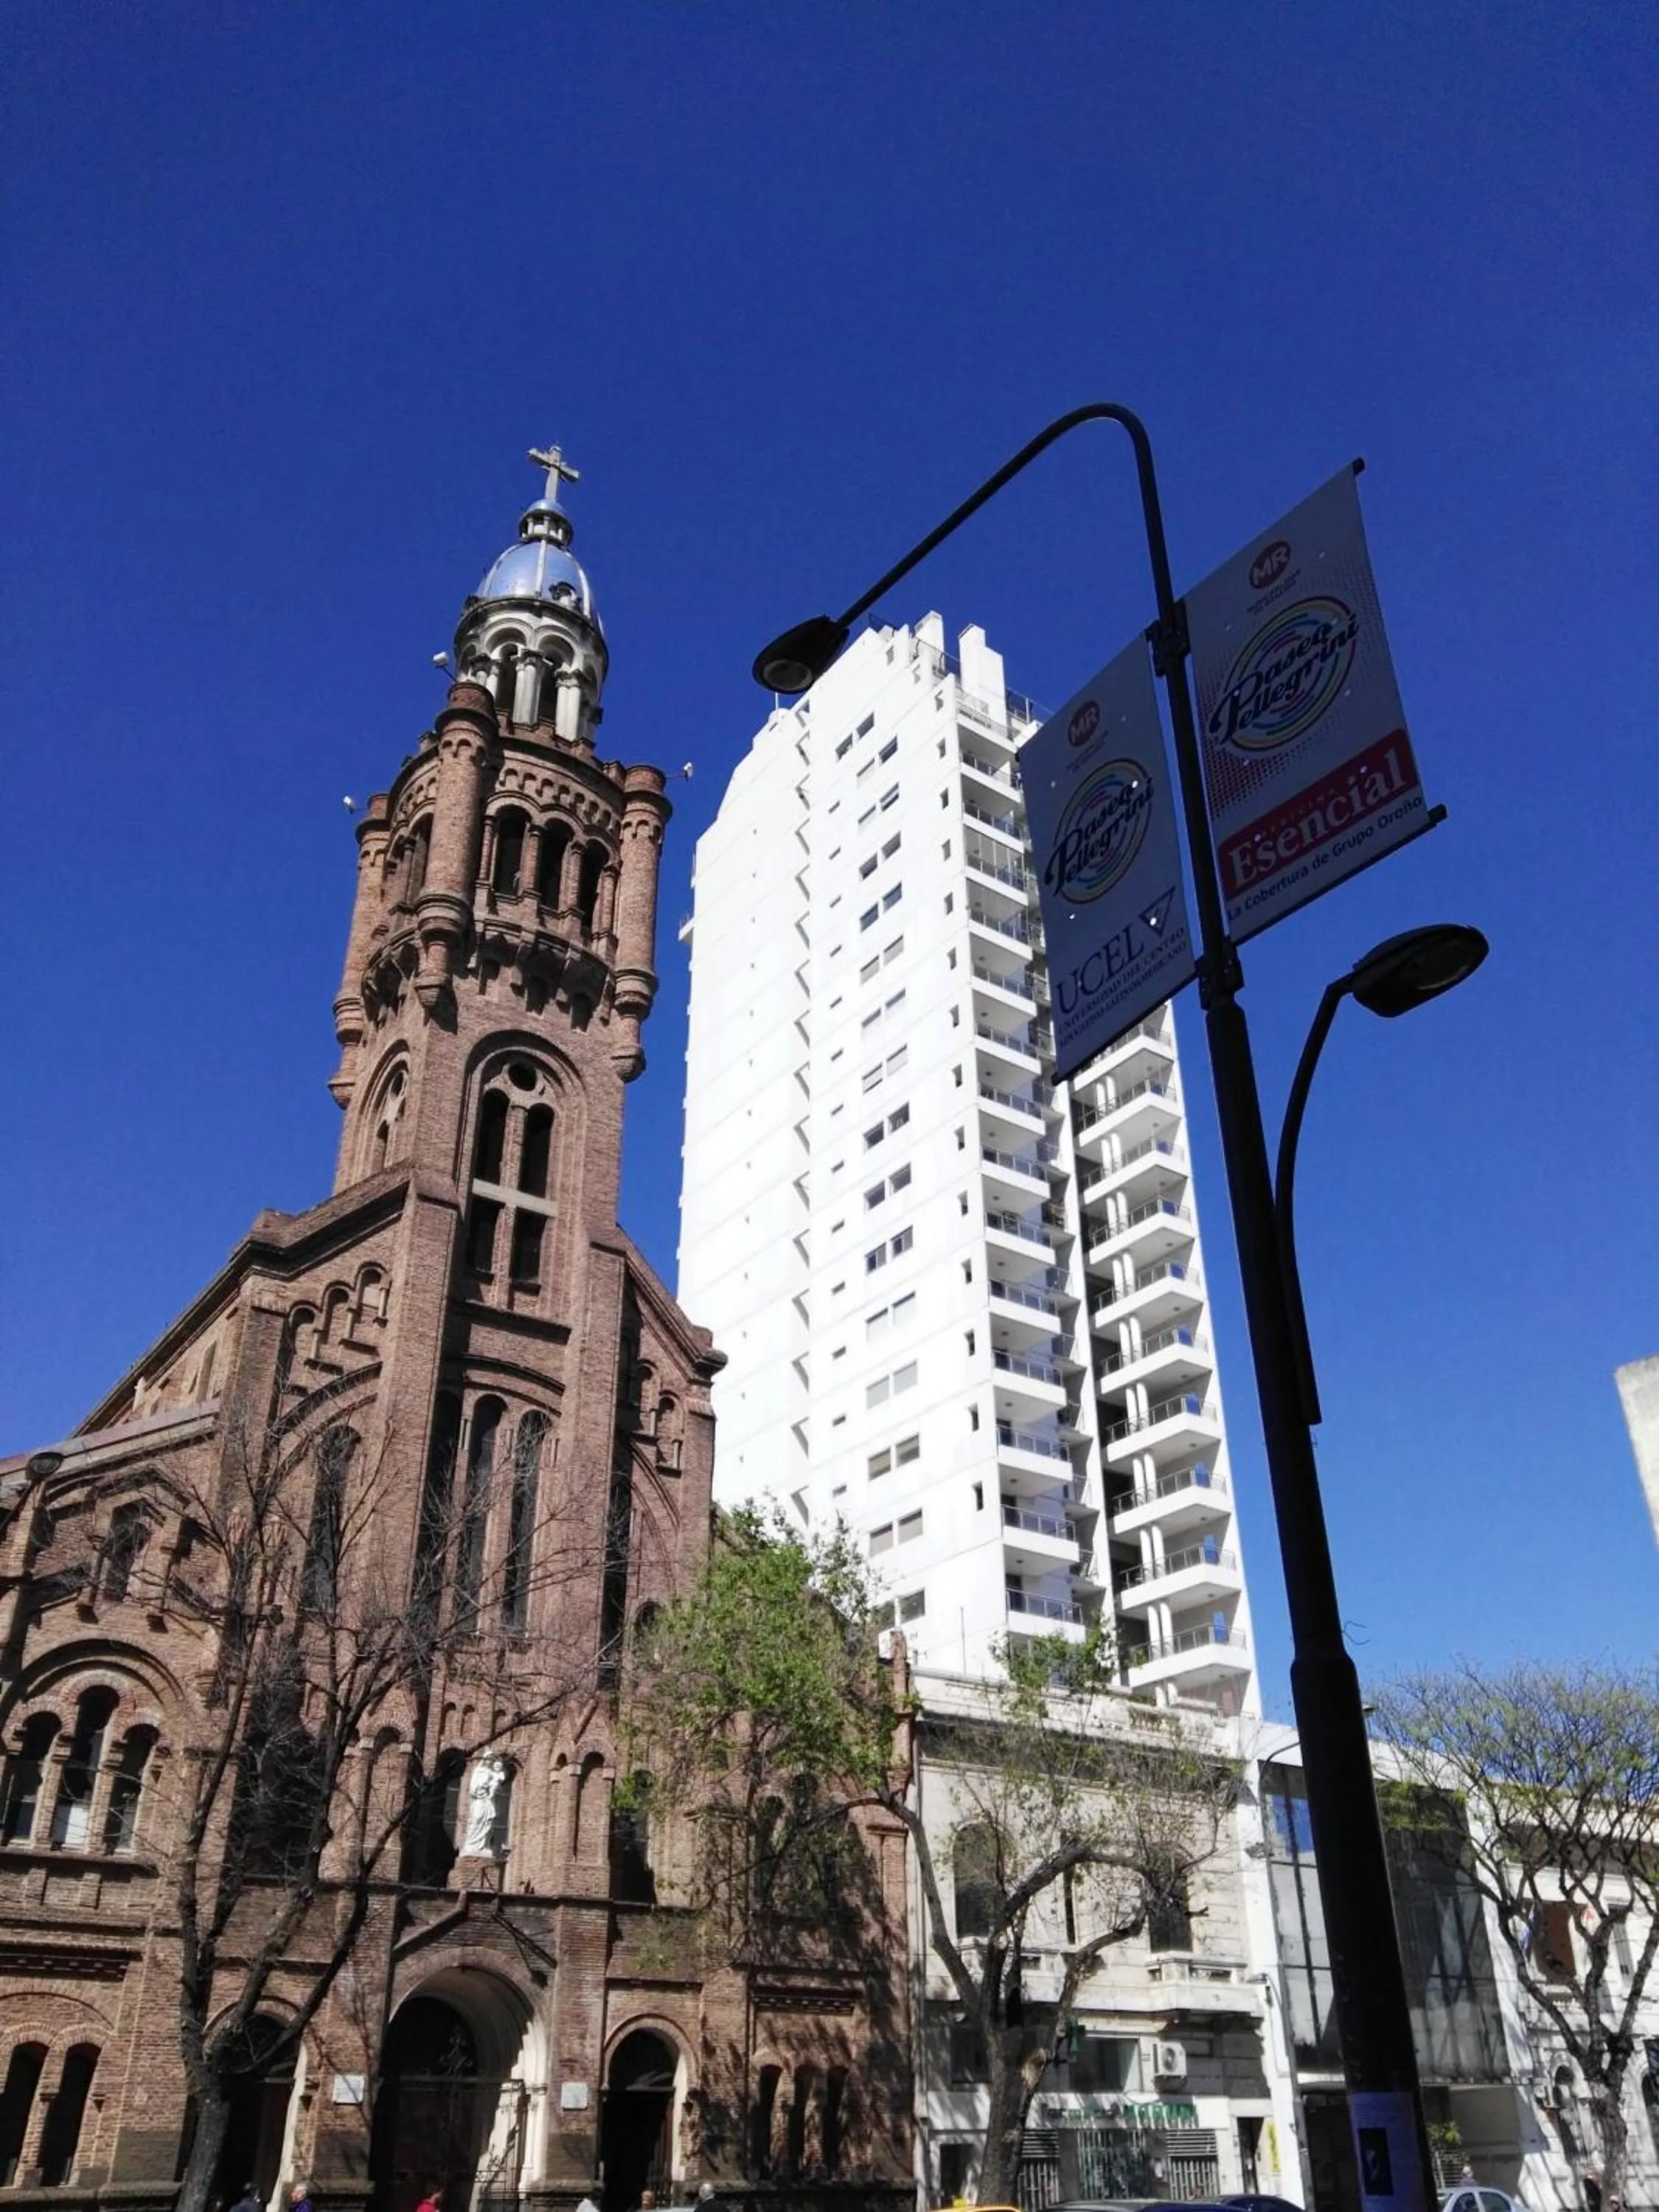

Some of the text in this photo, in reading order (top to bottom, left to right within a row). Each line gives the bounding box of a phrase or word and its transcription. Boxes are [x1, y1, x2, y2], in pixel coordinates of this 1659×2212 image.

[1252, 546, 1290, 585] MR
[1070, 706, 1098, 744] MR
[1209, 613, 1359, 745] Pellegrini
[1209, 622, 1332, 745] Paseo
[1045, 777, 1154, 896] Pellegrini
[1045, 784, 1134, 896] Paseo
[1227, 905, 1242, 921] La
[1245, 866, 1310, 909] Cobertura
[1312, 854, 1331, 870] de
[1332, 826, 1374, 857] Grupo
[1228, 747, 1405, 888] Esencial
[1055, 923, 1144, 1015] UCEL
